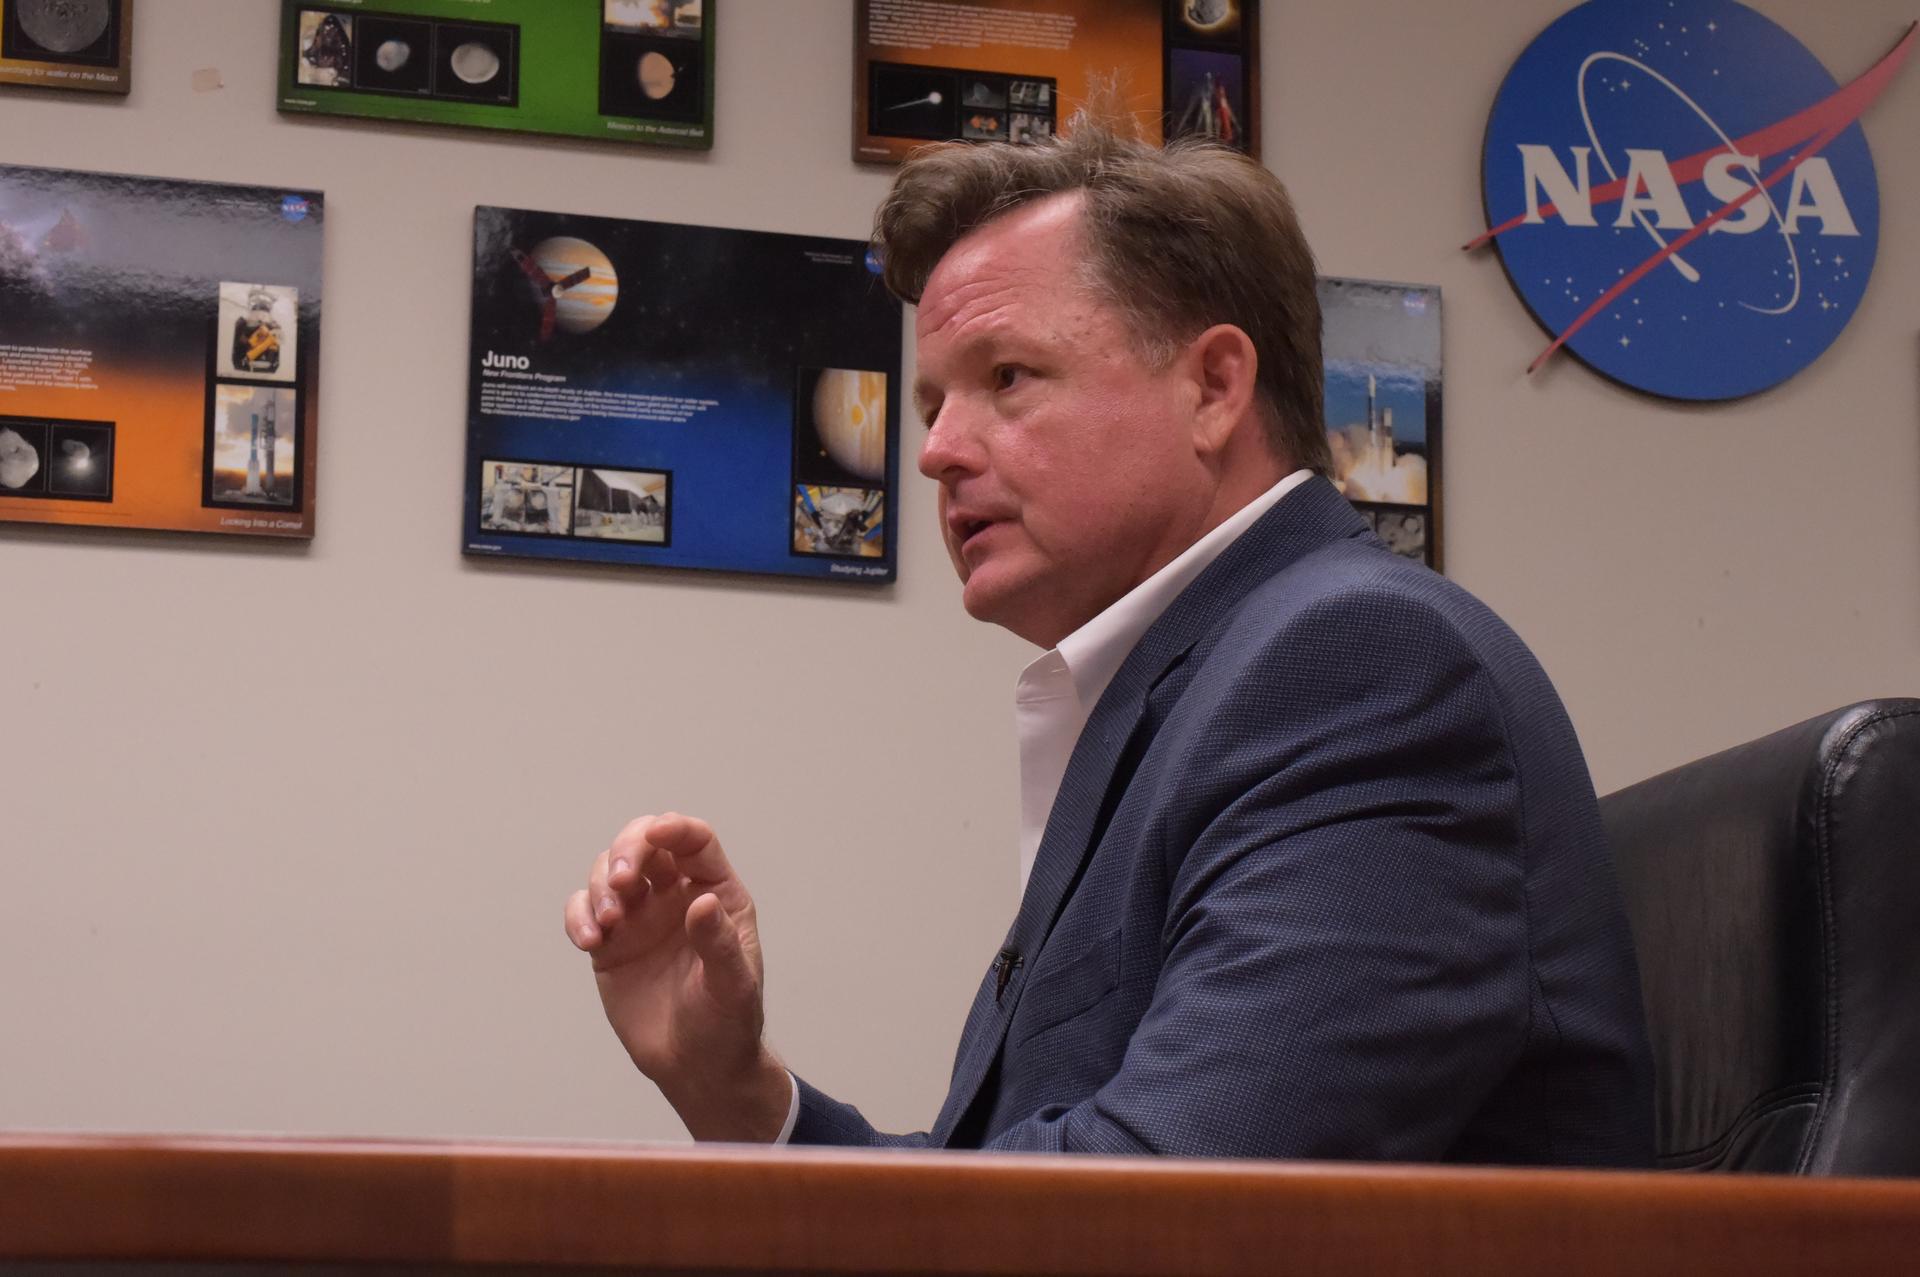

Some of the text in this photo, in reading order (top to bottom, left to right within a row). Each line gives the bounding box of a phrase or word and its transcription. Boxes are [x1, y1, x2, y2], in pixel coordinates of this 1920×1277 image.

[0, 66, 32, 76] earching
[95, 73, 118, 82] Moon
[1516, 144, 1861, 237] NASA
[281, 203, 307, 213] NASA
[481, 350, 530, 370] Juno
[482, 369, 567, 383] New Frontiers Program
[830, 563, 888, 576] Studying Jupiter
